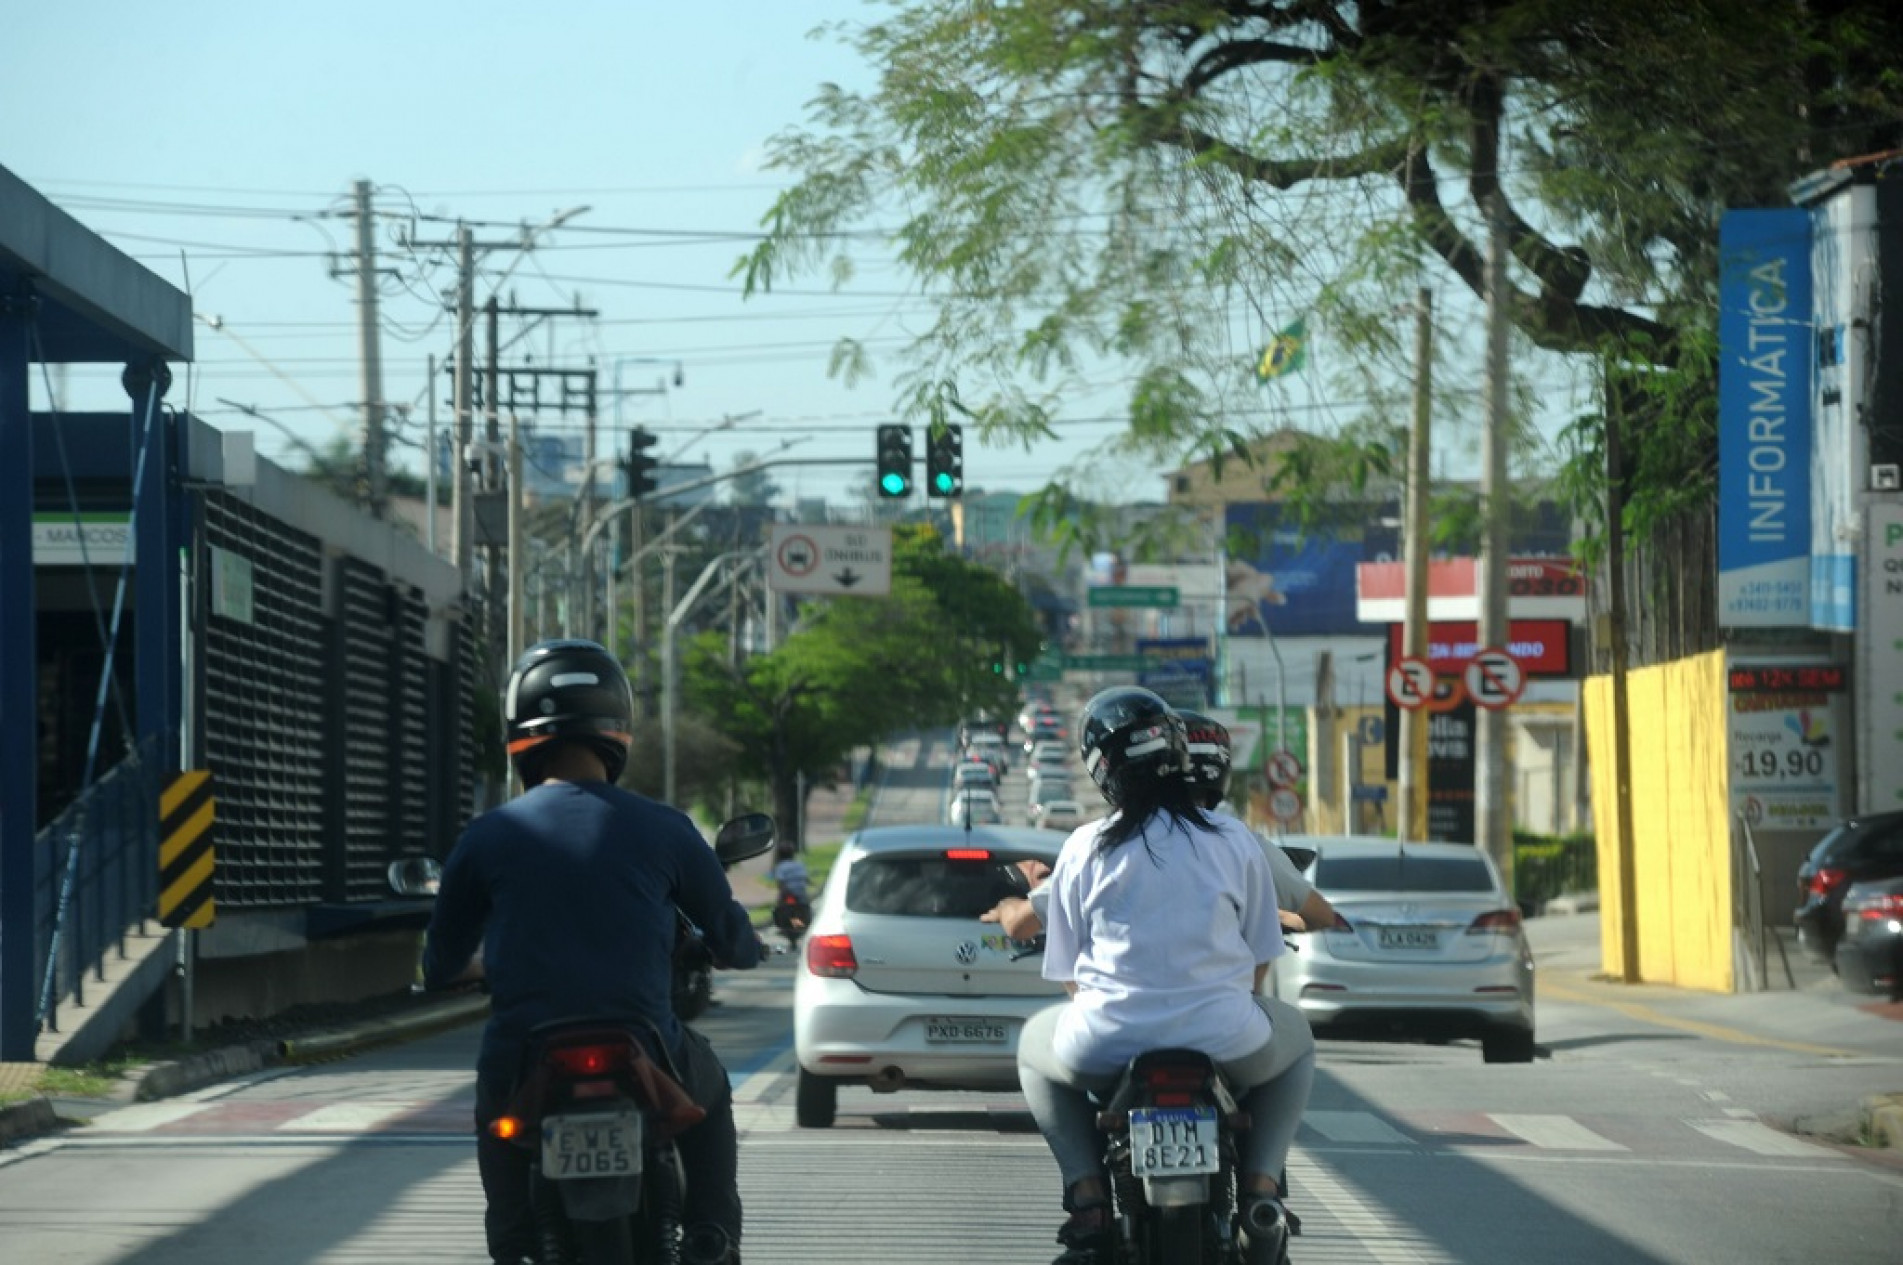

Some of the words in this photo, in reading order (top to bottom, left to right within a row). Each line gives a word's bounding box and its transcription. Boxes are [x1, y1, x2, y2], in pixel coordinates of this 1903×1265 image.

[1739, 256, 1788, 542] INFORMÁTICA
[1742, 749, 1823, 782] 19,90
[558, 1151, 630, 1175] 7065
[1144, 1145, 1207, 1170] 8E21
